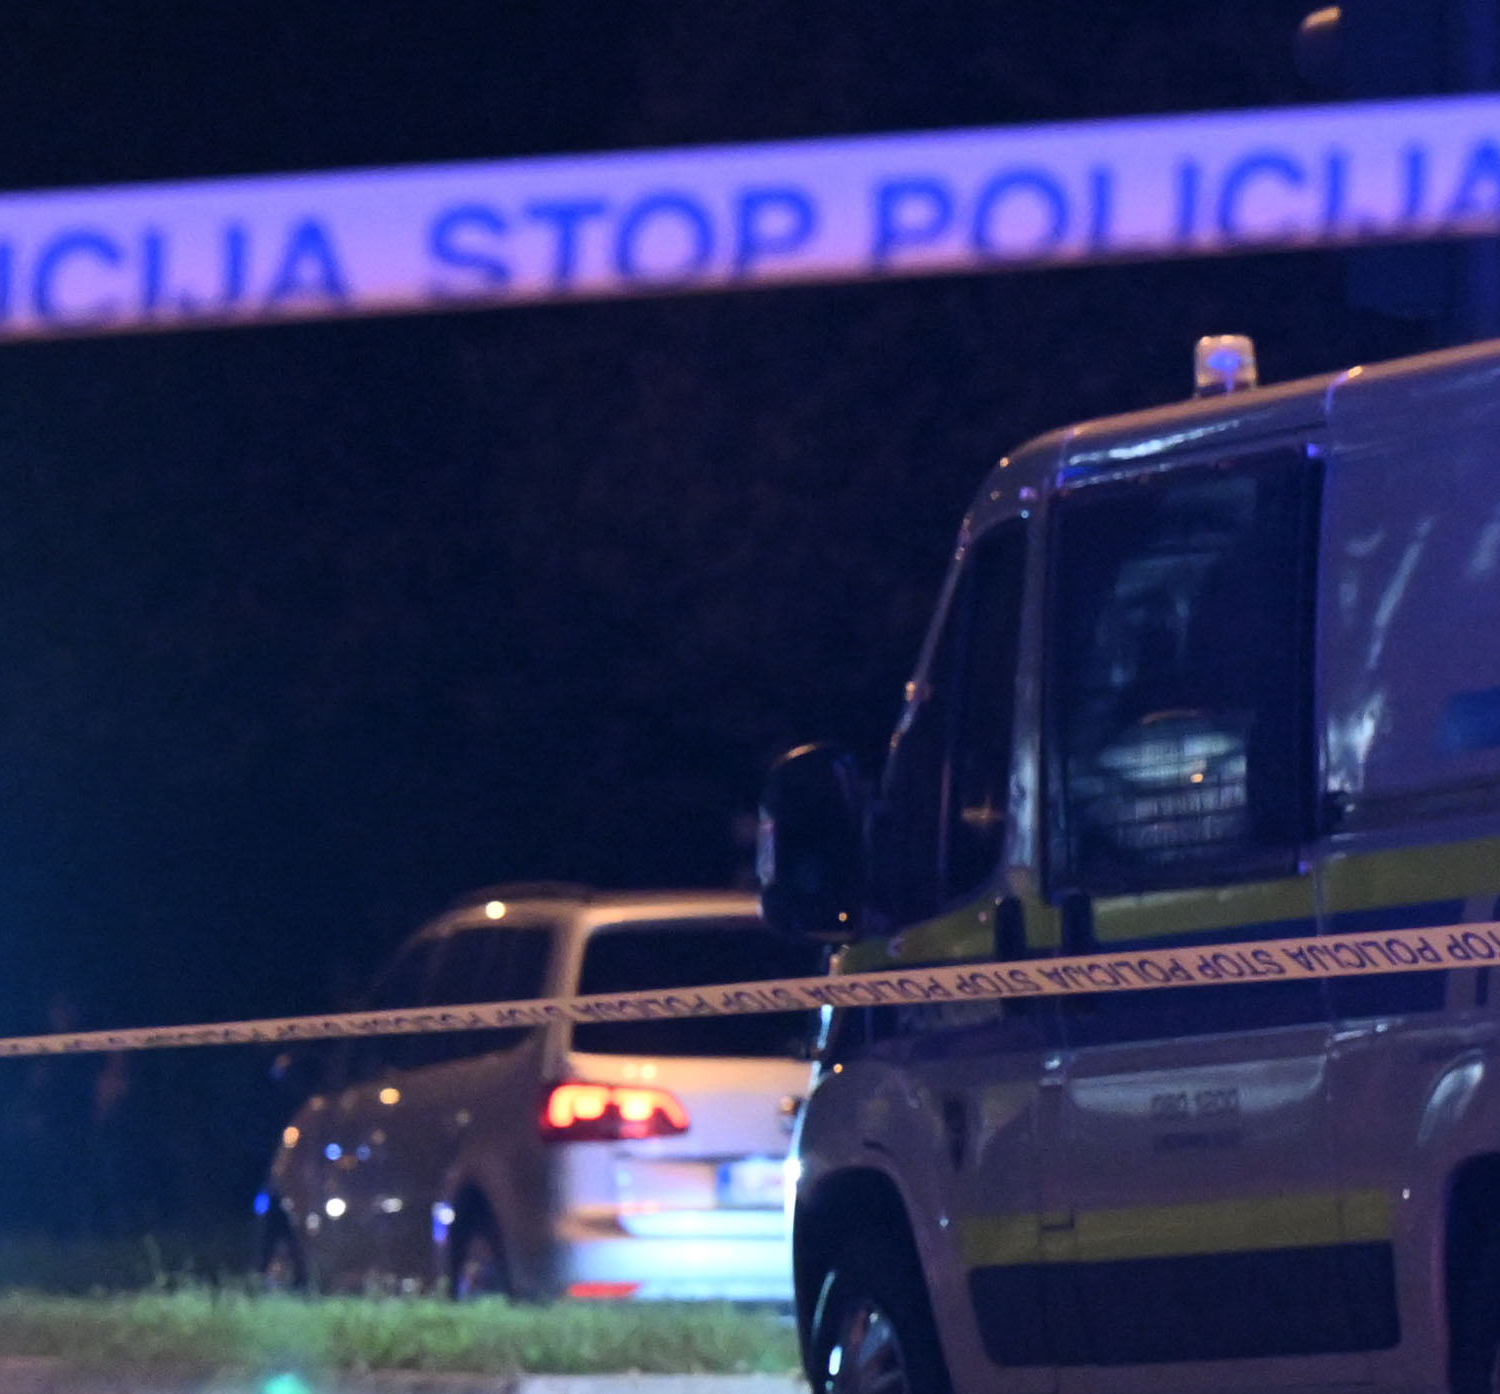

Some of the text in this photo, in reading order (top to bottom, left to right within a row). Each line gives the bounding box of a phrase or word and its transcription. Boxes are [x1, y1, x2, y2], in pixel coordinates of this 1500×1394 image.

[426, 183, 821, 303] STOP
[1197, 949, 1287, 980] STOP
[1283, 936, 1443, 973] POLICIJA
